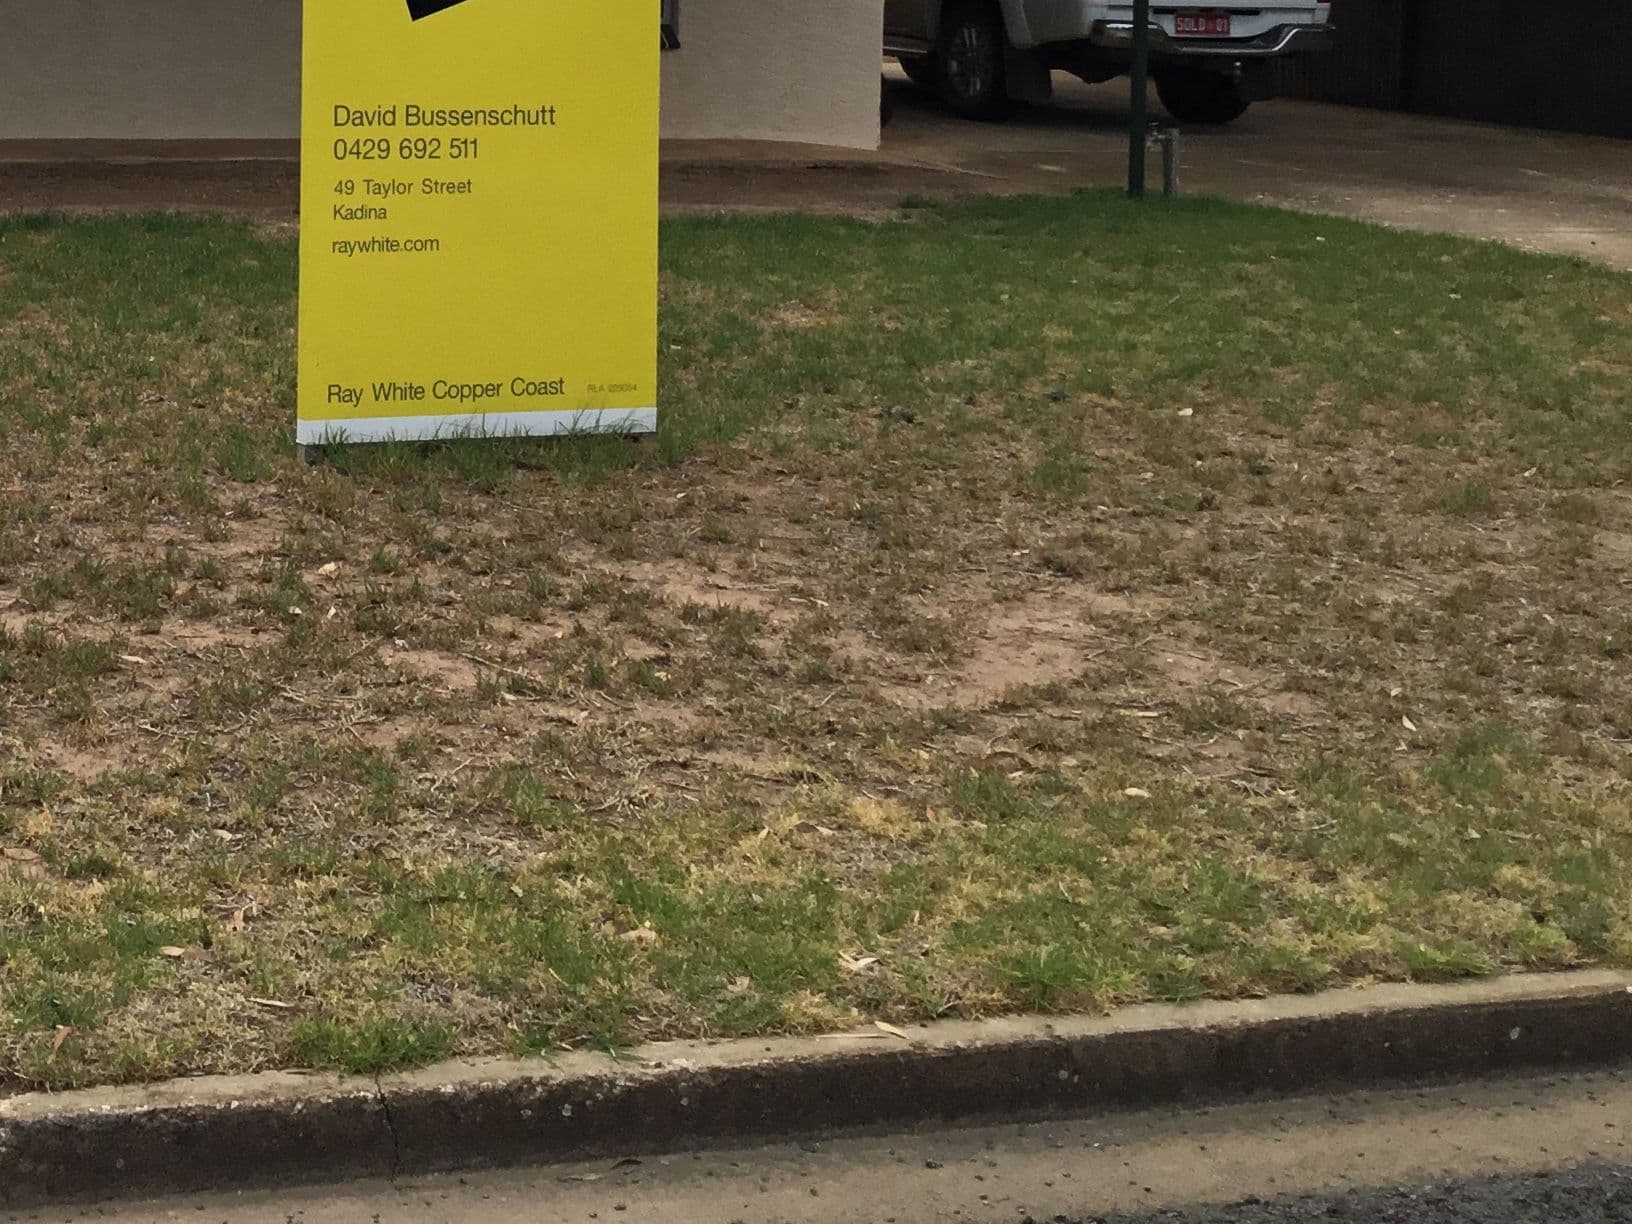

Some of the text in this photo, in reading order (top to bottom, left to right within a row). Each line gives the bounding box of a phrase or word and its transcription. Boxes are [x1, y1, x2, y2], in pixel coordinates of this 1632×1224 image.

[333, 103, 557, 127] David Bussenschutt
[333, 137, 478, 161] 0429 692 511
[333, 177, 473, 200] 49 Taylor Street
[333, 204, 388, 221] Kadina
[332, 236, 440, 258] raywhite.com
[327, 376, 565, 408] Ray White Copper Coast
